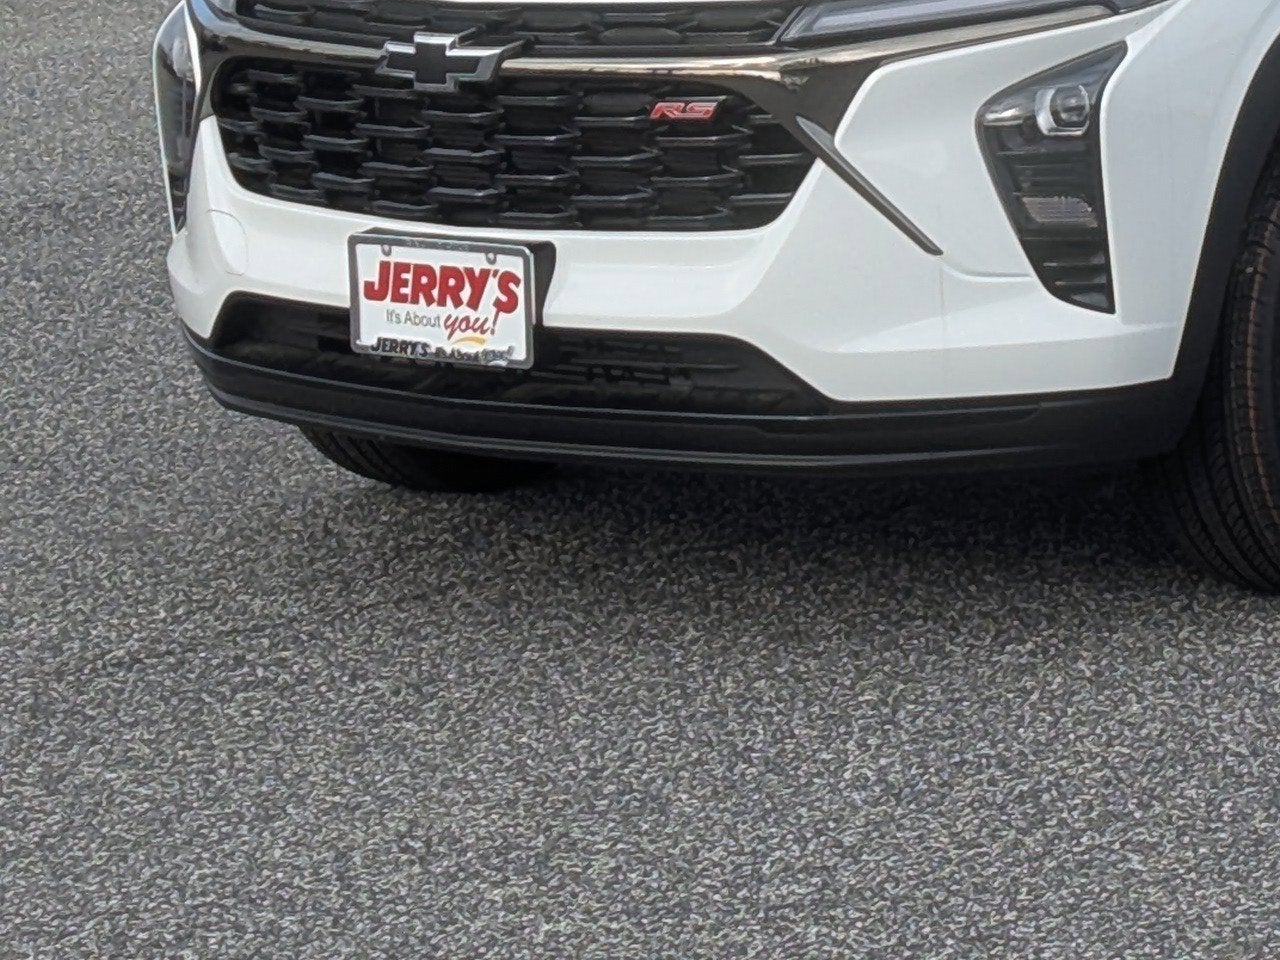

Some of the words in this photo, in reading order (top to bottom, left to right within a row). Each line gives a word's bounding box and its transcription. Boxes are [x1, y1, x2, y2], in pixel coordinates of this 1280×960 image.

[649, 102, 718, 119] RS
[363, 260, 522, 315] JERRY'S
[386, 309, 402, 323] It's
[404, 310, 441, 327] About
[443, 310, 500, 341] you!
